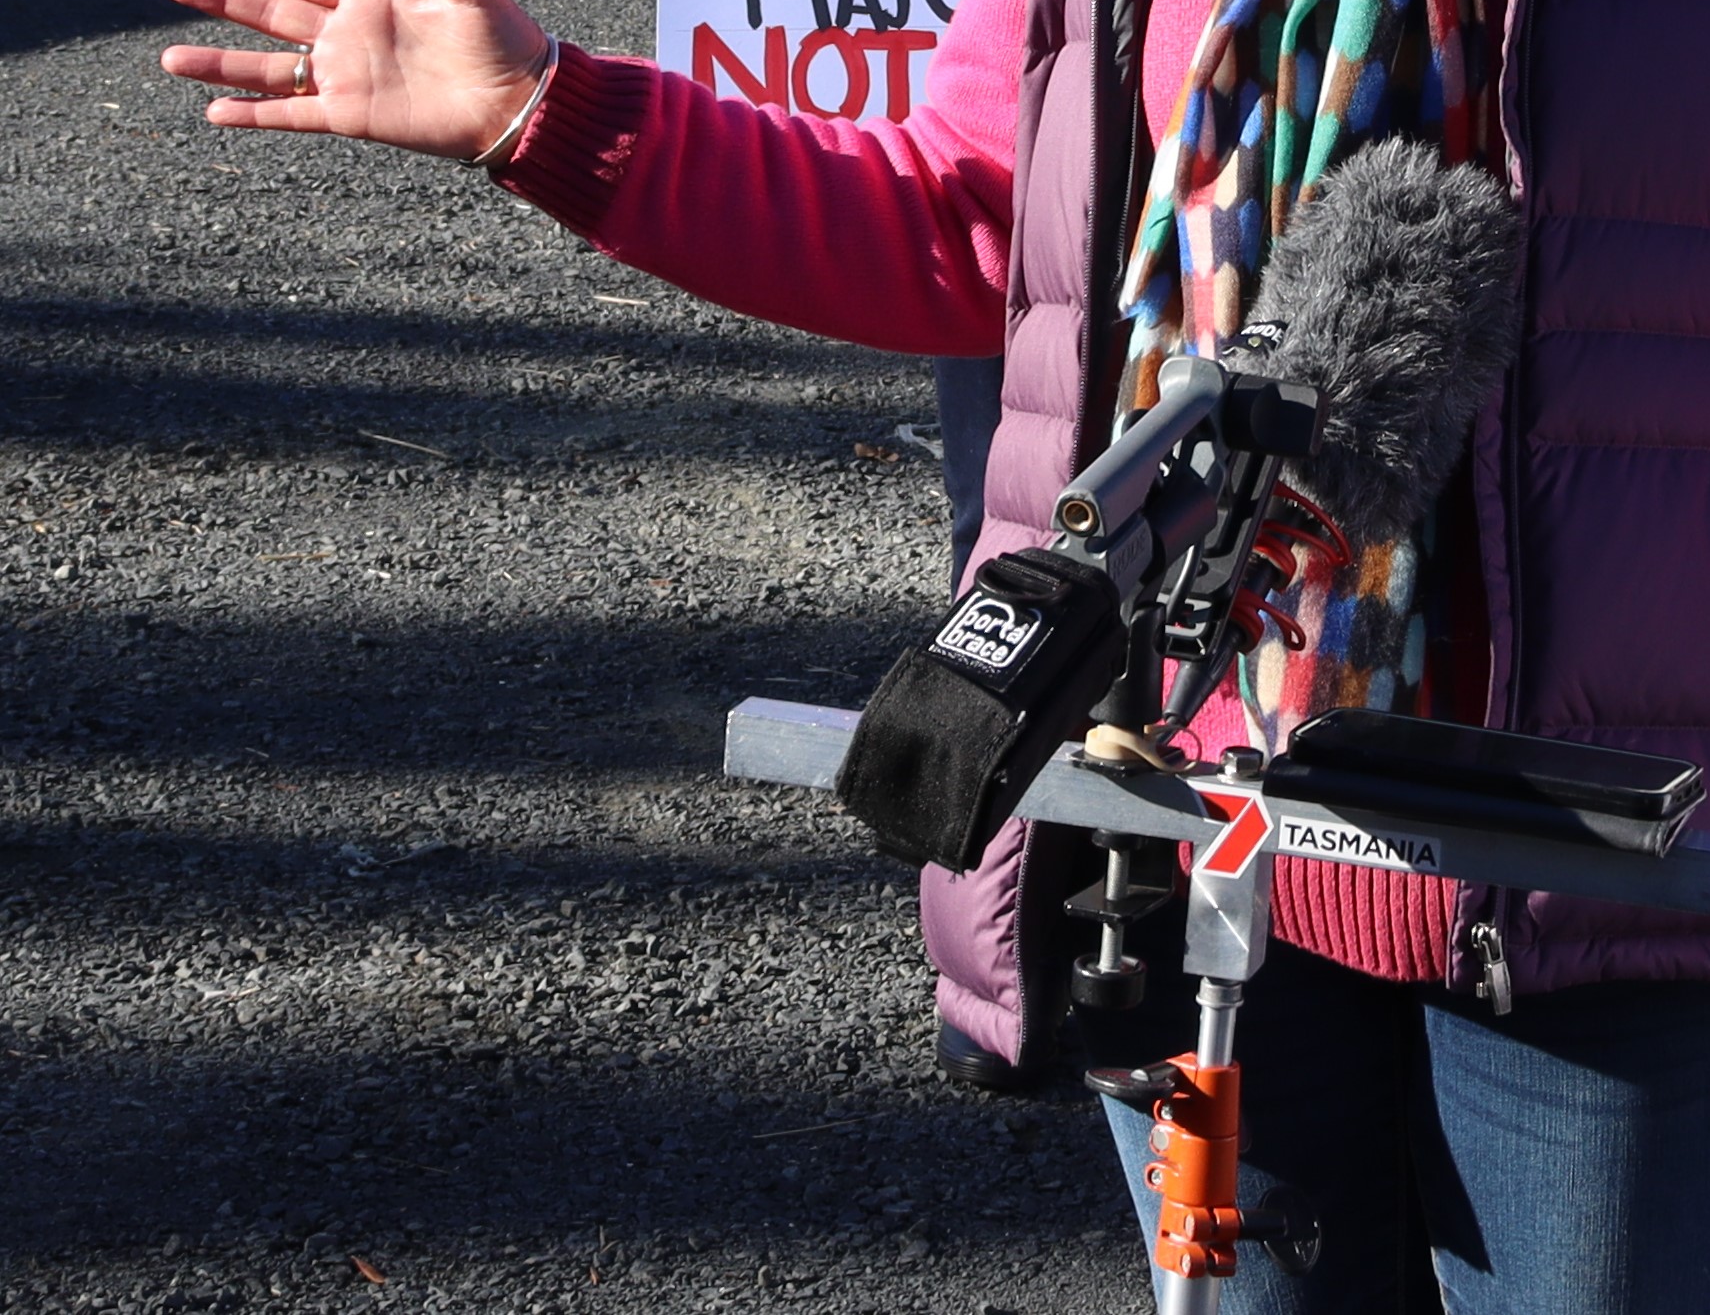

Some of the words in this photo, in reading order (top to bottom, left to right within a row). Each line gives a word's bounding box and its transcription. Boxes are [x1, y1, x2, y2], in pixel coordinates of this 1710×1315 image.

[692, 22, 938, 126] NOT
[943, 627, 1009, 662] brace
[956, 603, 1030, 645] porta
[1284, 823, 1437, 868] TASMANIA
